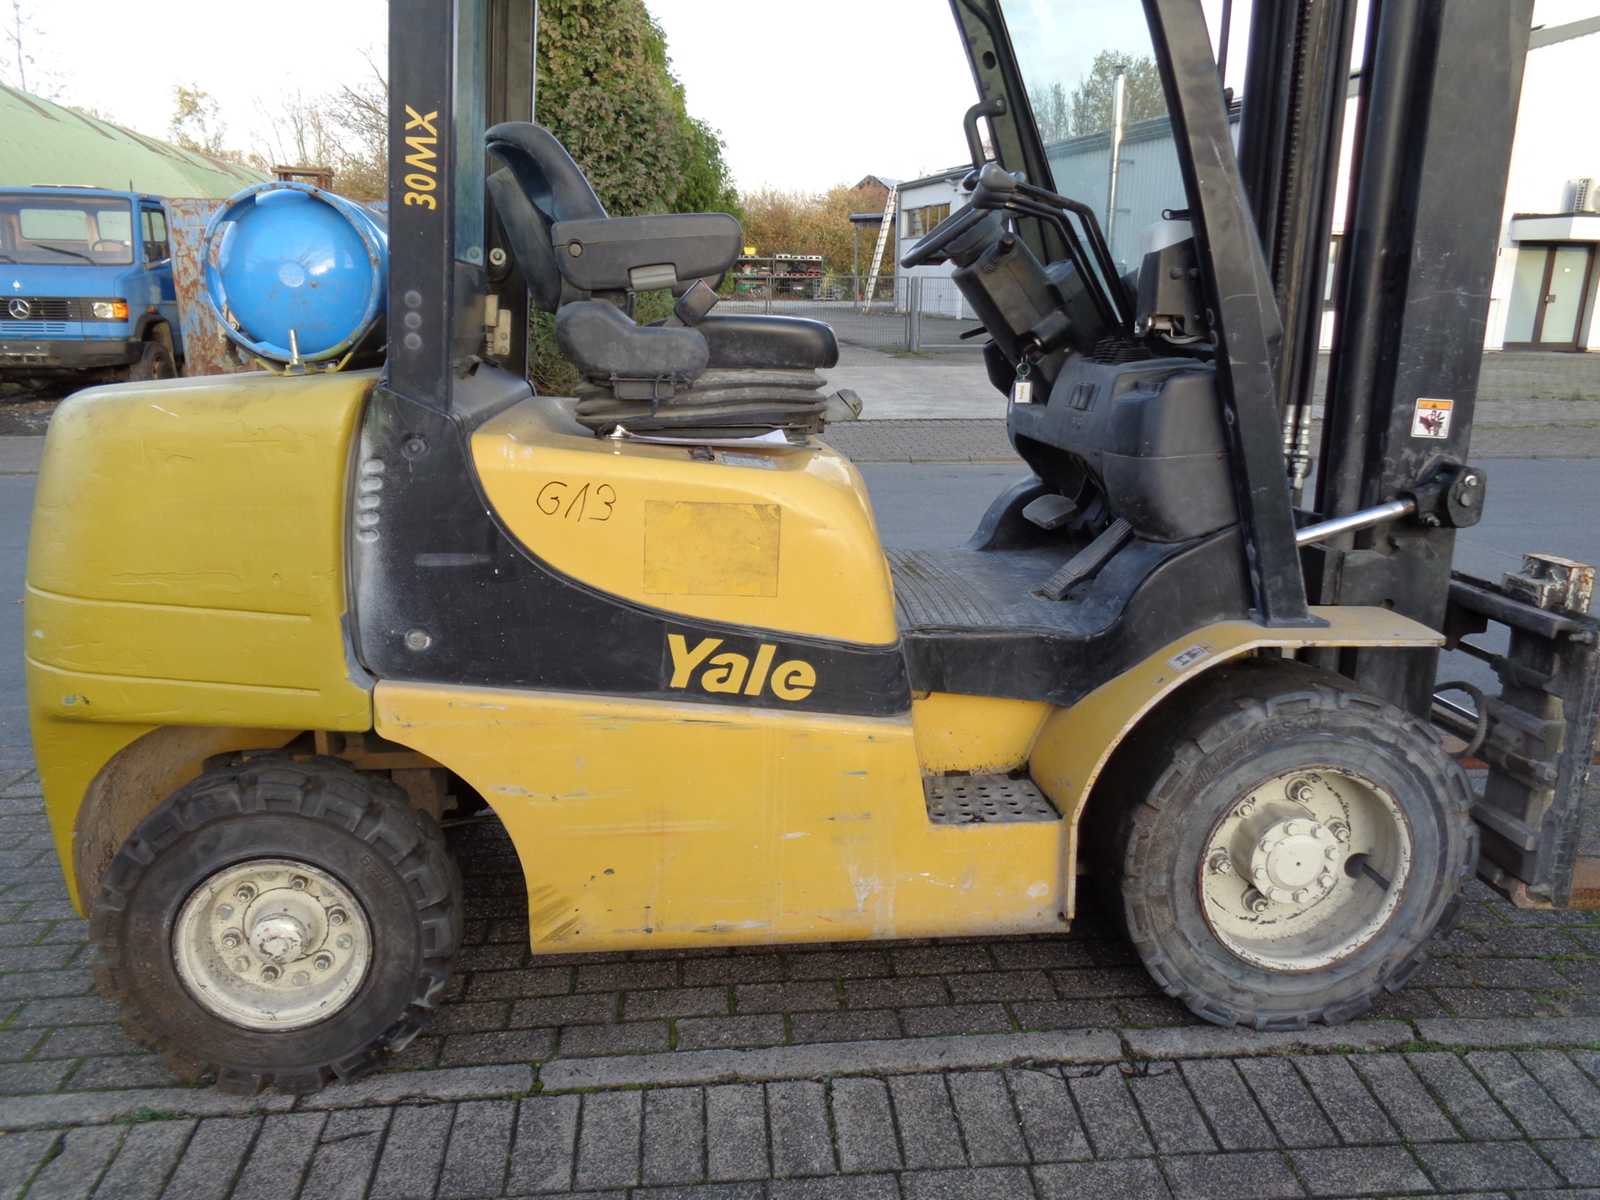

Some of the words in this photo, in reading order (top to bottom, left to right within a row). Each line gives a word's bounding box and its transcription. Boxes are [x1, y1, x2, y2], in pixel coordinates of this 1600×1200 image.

[404, 104, 438, 210] 30MX
[536, 481, 617, 522] G13
[667, 633, 817, 701] Yale
